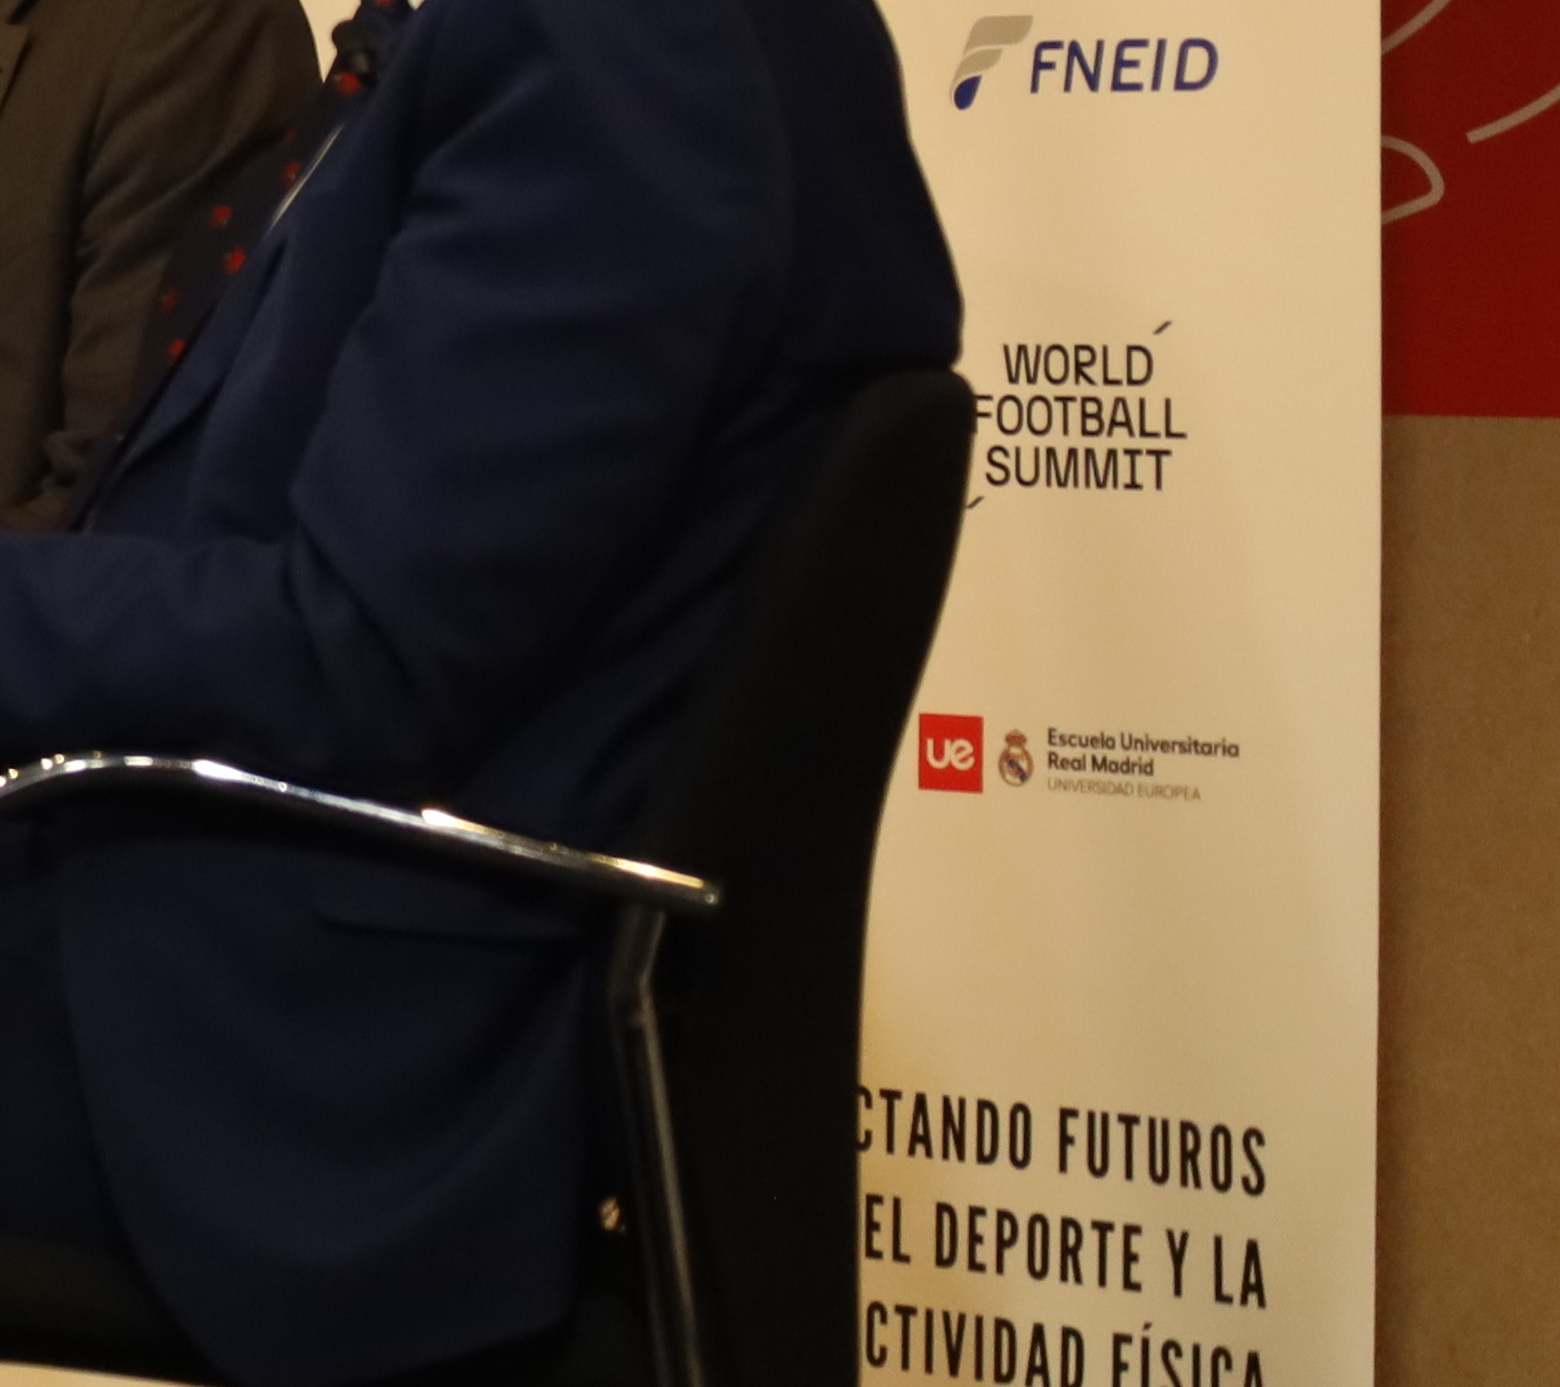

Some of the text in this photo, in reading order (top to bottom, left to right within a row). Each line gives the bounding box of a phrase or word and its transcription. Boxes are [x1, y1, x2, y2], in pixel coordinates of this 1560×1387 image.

[1030, 37, 1219, 94] FNEID
[1003, 344, 1154, 386] WORLD
[974, 395, 1188, 439] FOOTBALL
[985, 445, 1172, 491] SUMMIT
[926, 738, 974, 770] ue
[1047, 728, 1239, 758] Escuela Universitaria
[1047, 752, 1154, 776] Real Madrid
[1047, 779, 1133, 797] UNIVERSIDAD
[856, 1085, 1266, 1197] CTANDO FUTUROS
[936, 1202, 1142, 1293] DEPORTE
[1167, 1229, 1189, 1297] Y
[1214, 1235, 1267, 1309] LA
[865, 1301, 1085, 1387] CTIVIDAD
